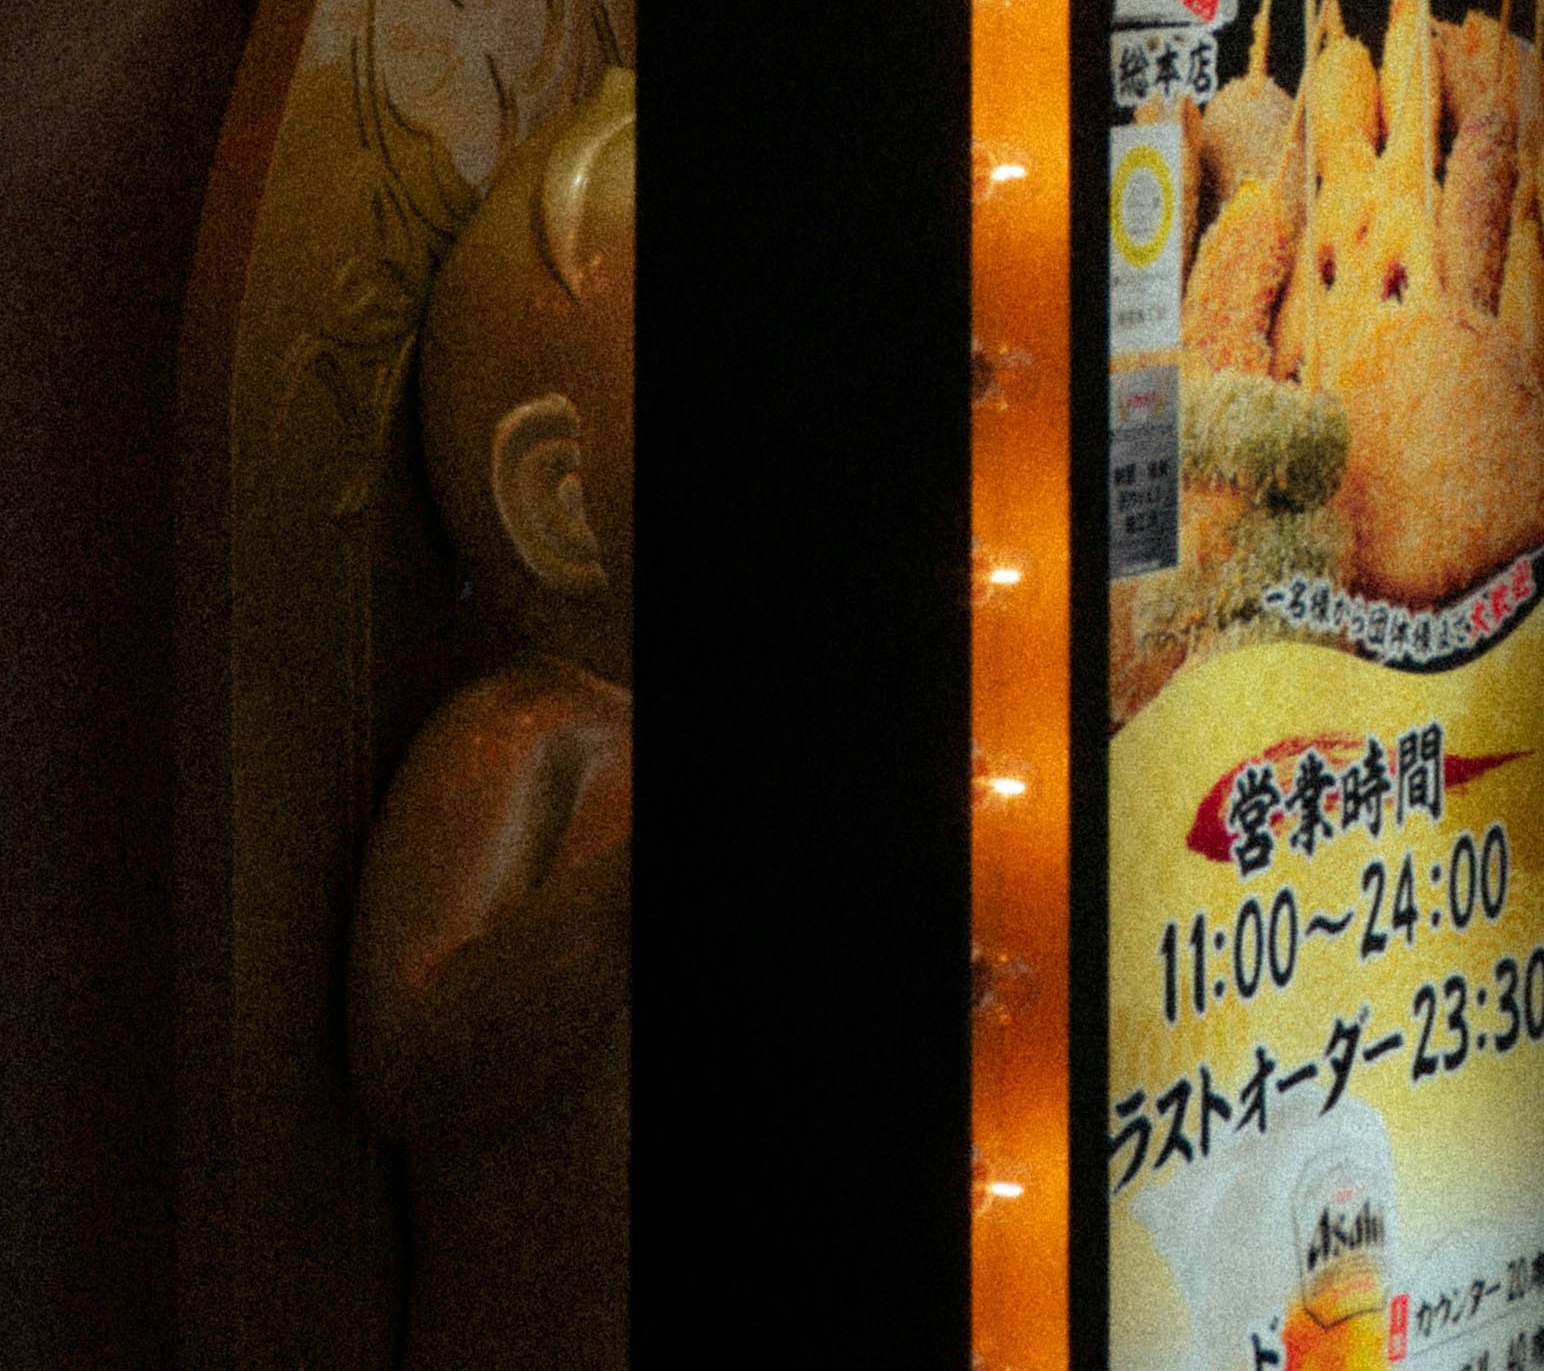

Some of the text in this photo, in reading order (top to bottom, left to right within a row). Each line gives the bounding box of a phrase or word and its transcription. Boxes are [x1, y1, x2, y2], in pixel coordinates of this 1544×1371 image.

[1119, 41, 1212, 97] 総本店
[1228, 722, 1444, 877] 営業時間
